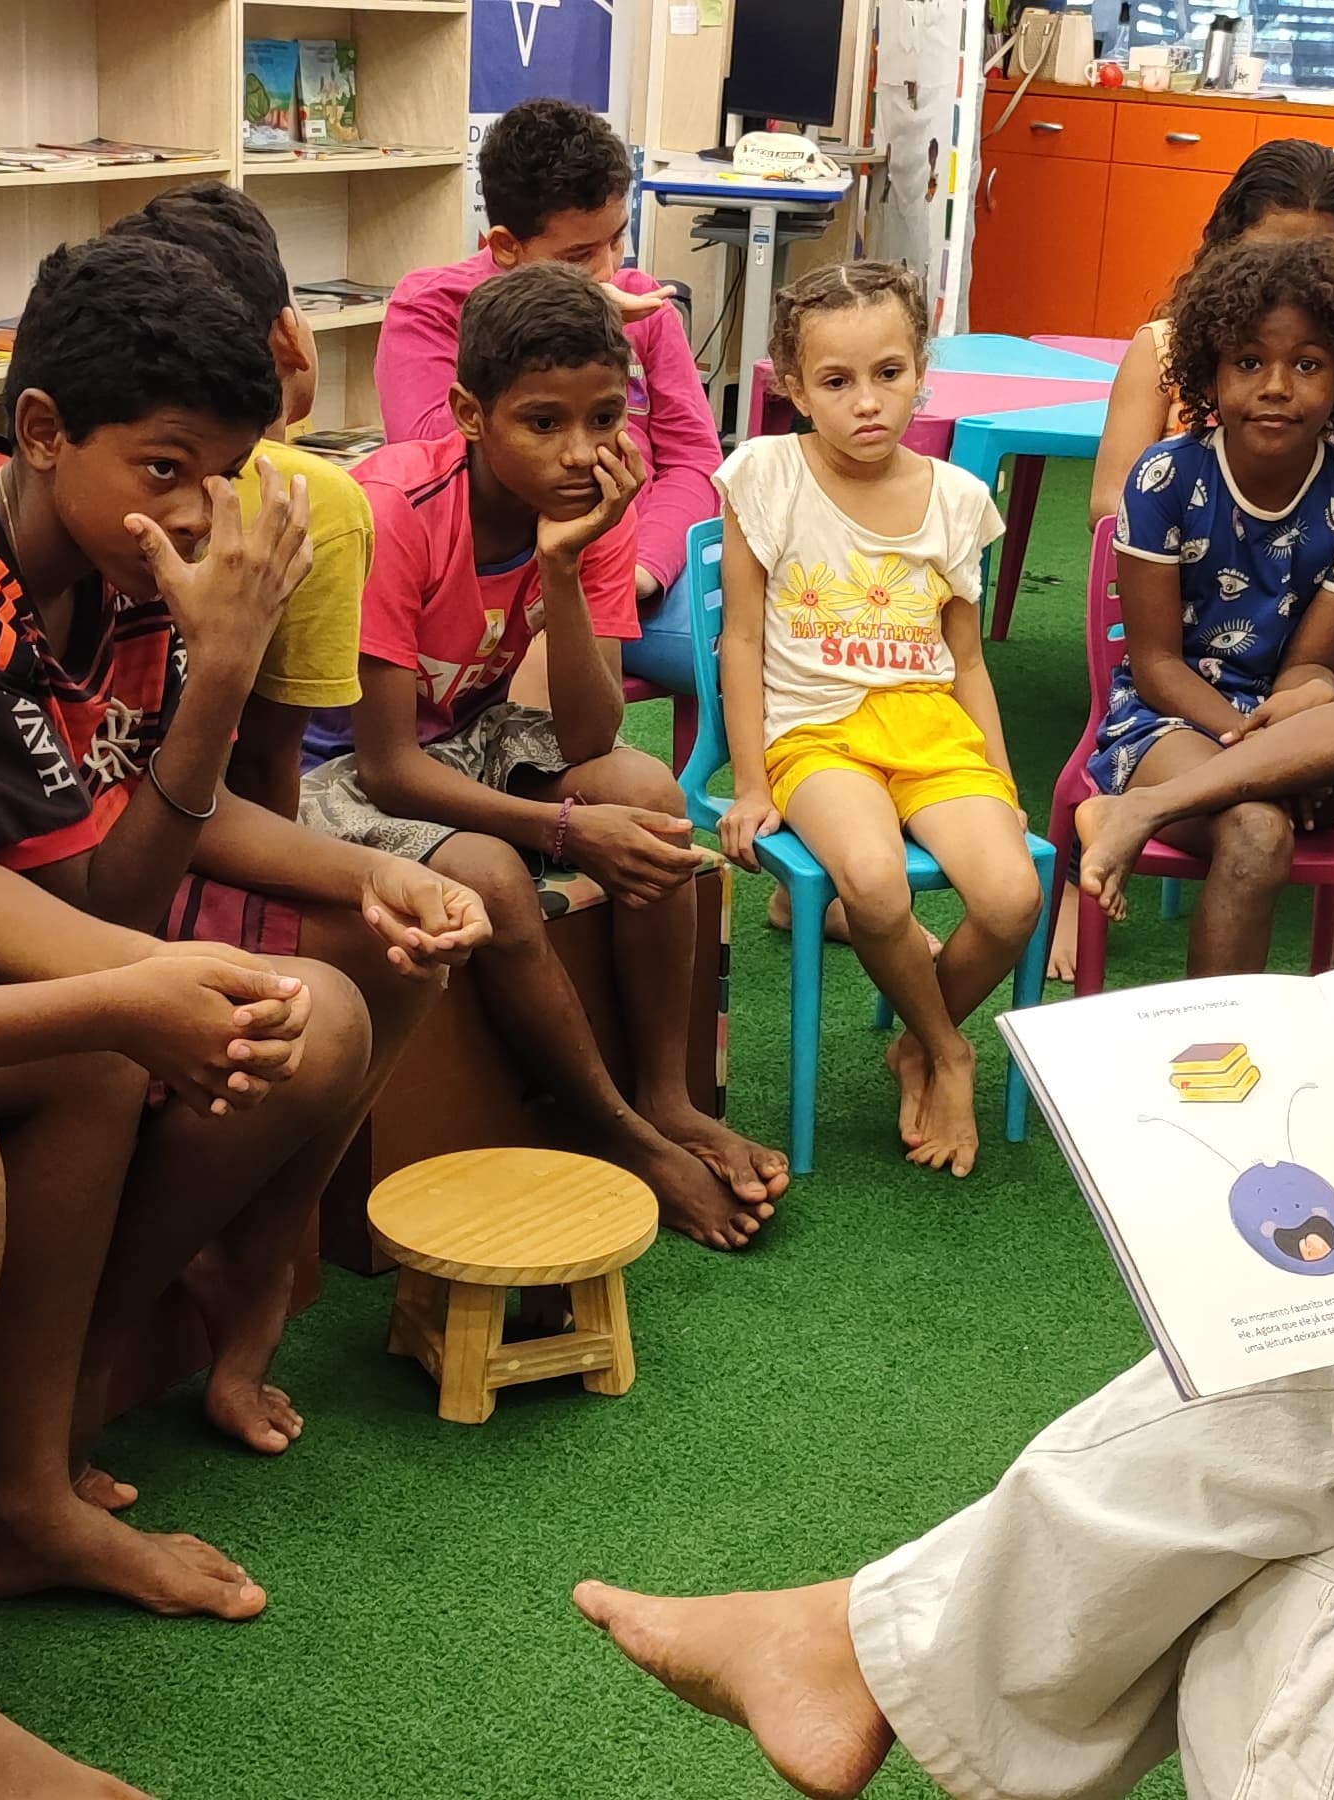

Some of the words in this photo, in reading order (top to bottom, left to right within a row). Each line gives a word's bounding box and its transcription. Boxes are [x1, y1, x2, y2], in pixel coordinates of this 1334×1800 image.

[791, 621, 851, 639] HAPPY
[857, 622, 933, 644] WITHOUT
[820, 638, 936, 670] SMILEY
[10, 697, 77, 799] HAVA
